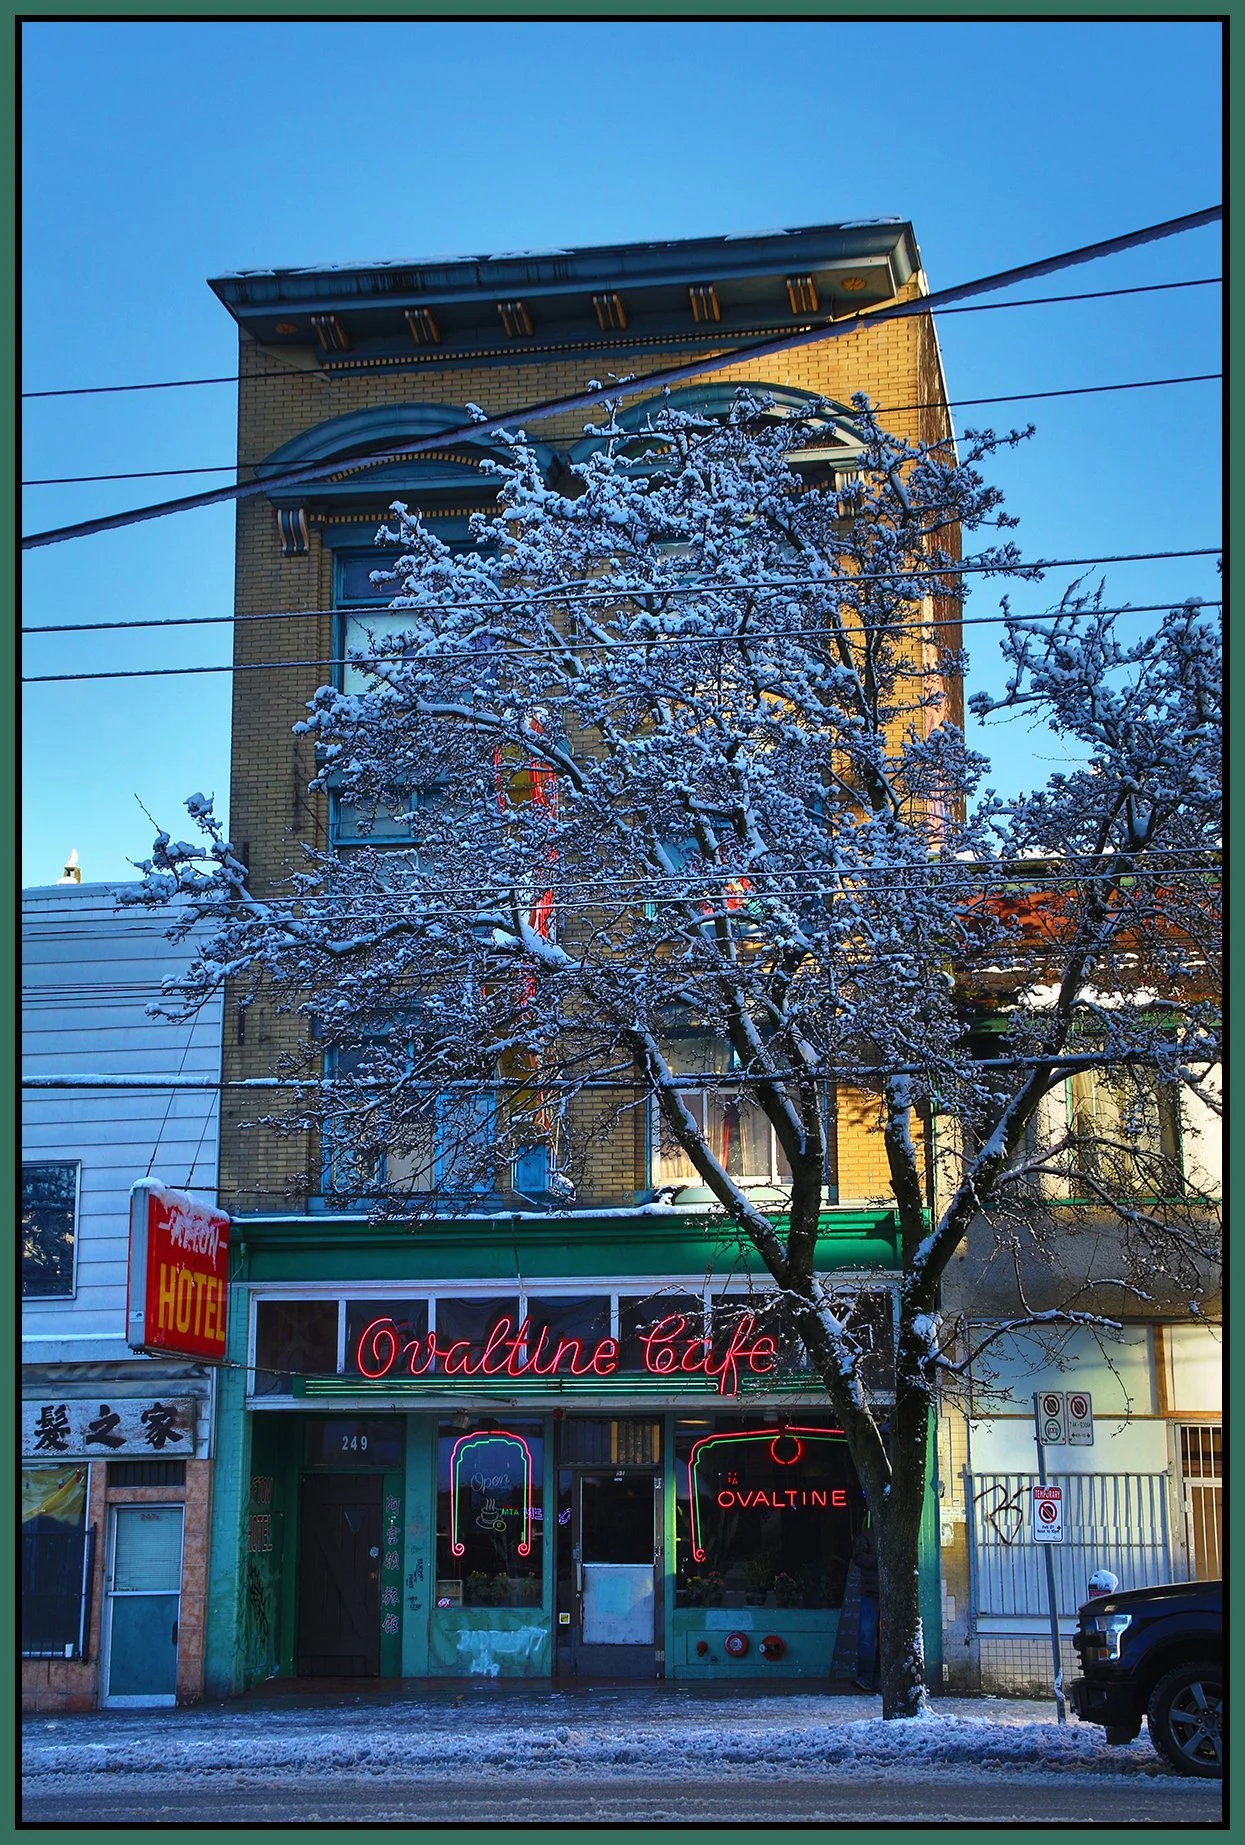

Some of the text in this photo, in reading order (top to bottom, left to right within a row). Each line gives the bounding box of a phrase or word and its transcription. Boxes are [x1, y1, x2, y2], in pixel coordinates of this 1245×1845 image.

[158, 1263, 225, 1341] HOTEL
[357, 1313, 774, 1397] Ovaltine Cafe
[342, 1435, 368, 1451] 249
[471, 1472, 511, 1494] Open
[717, 1490, 847, 1508] OVALTINE
